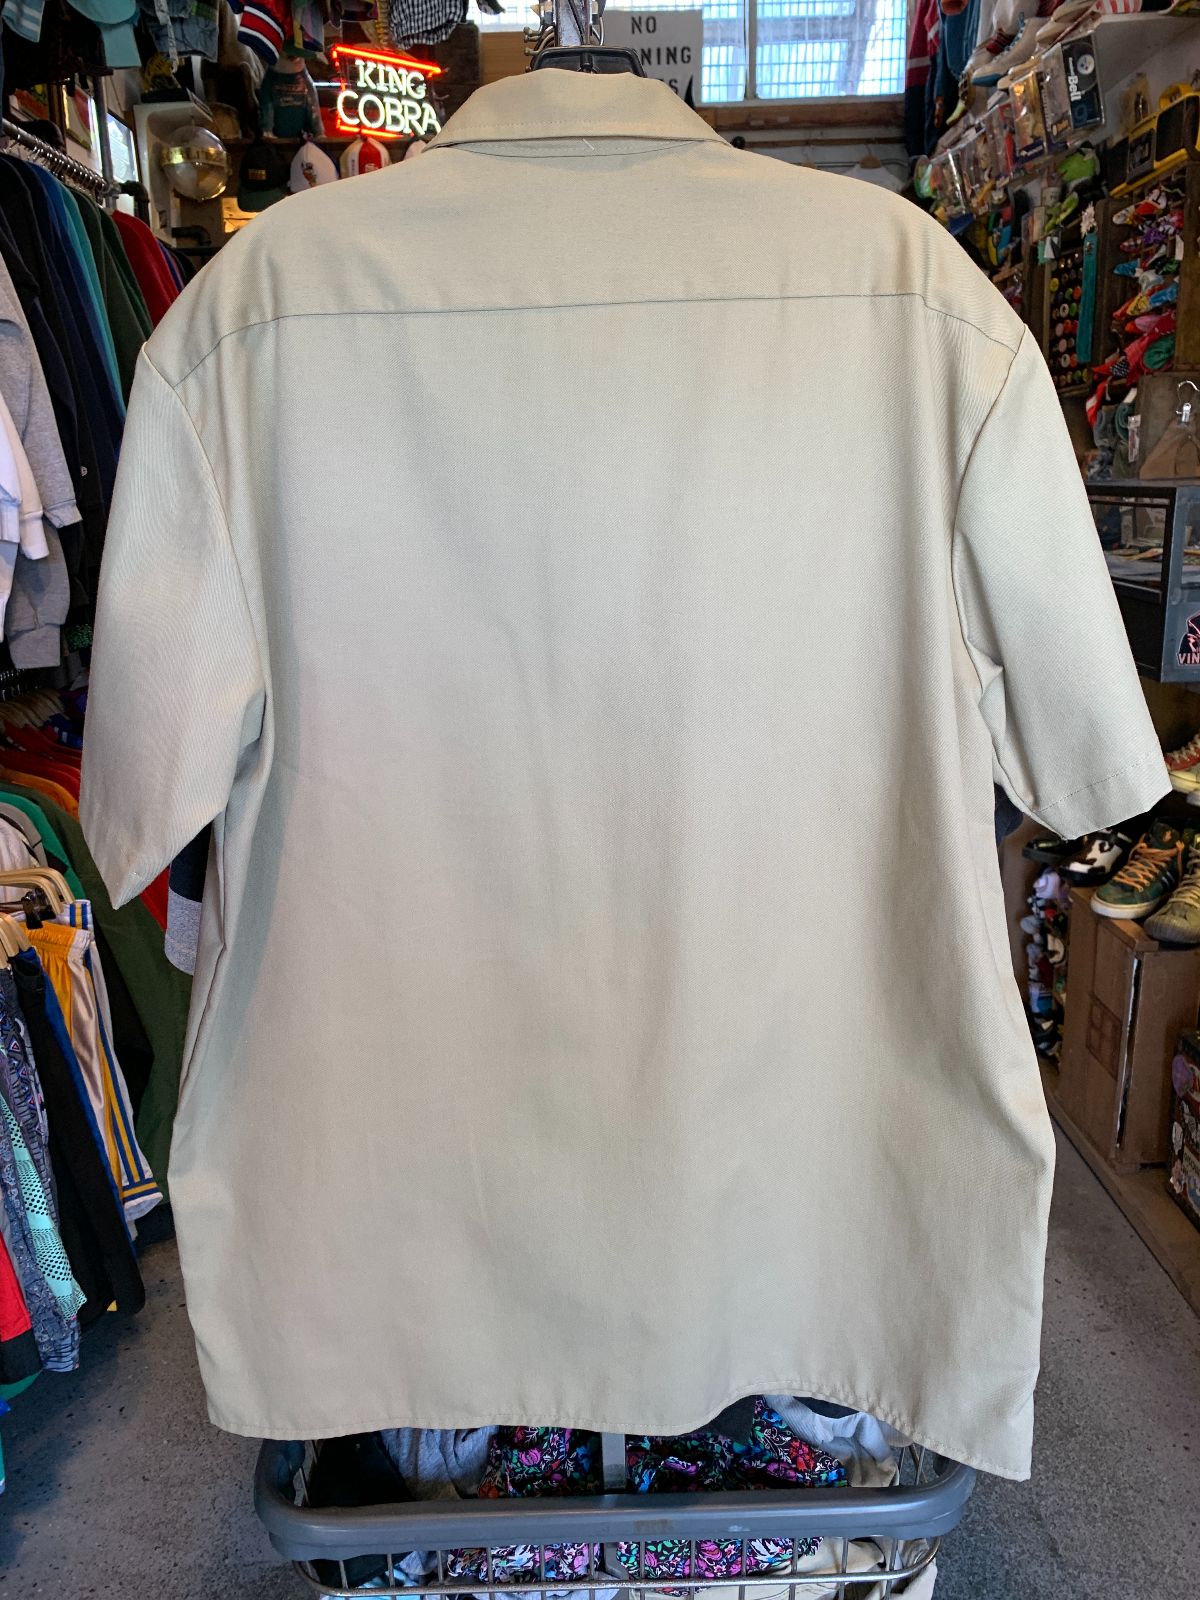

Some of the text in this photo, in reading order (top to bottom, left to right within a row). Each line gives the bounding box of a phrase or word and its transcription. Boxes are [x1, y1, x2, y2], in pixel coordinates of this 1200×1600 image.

[631, 16, 657, 34] NO
[640, 46, 692, 65] NING
[355, 58, 427, 99] KING
[1067, 75, 1083, 102] Bell
[337, 90, 442, 136] COBRA
